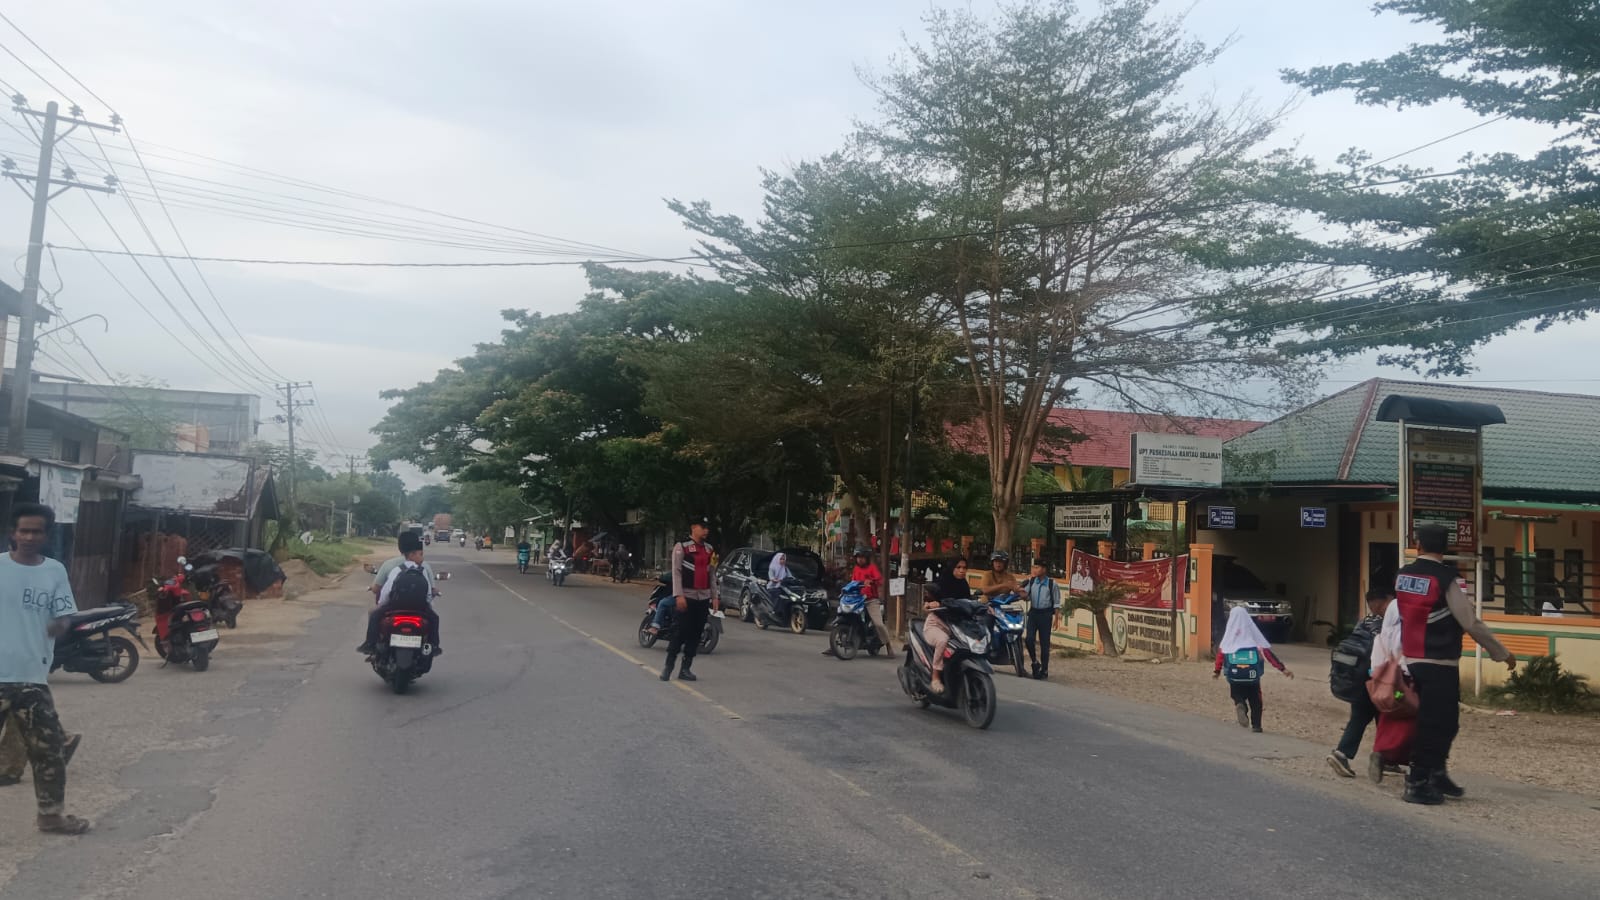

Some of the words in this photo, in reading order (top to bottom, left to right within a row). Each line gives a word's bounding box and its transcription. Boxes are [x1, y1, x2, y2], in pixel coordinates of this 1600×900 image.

[1149, 448, 1178, 456] PUSKESMAS
[1179, 450, 1199, 458] RANTAU
[1460, 525, 1471, 535] 24
[1398, 576, 1428, 593] POLISI
